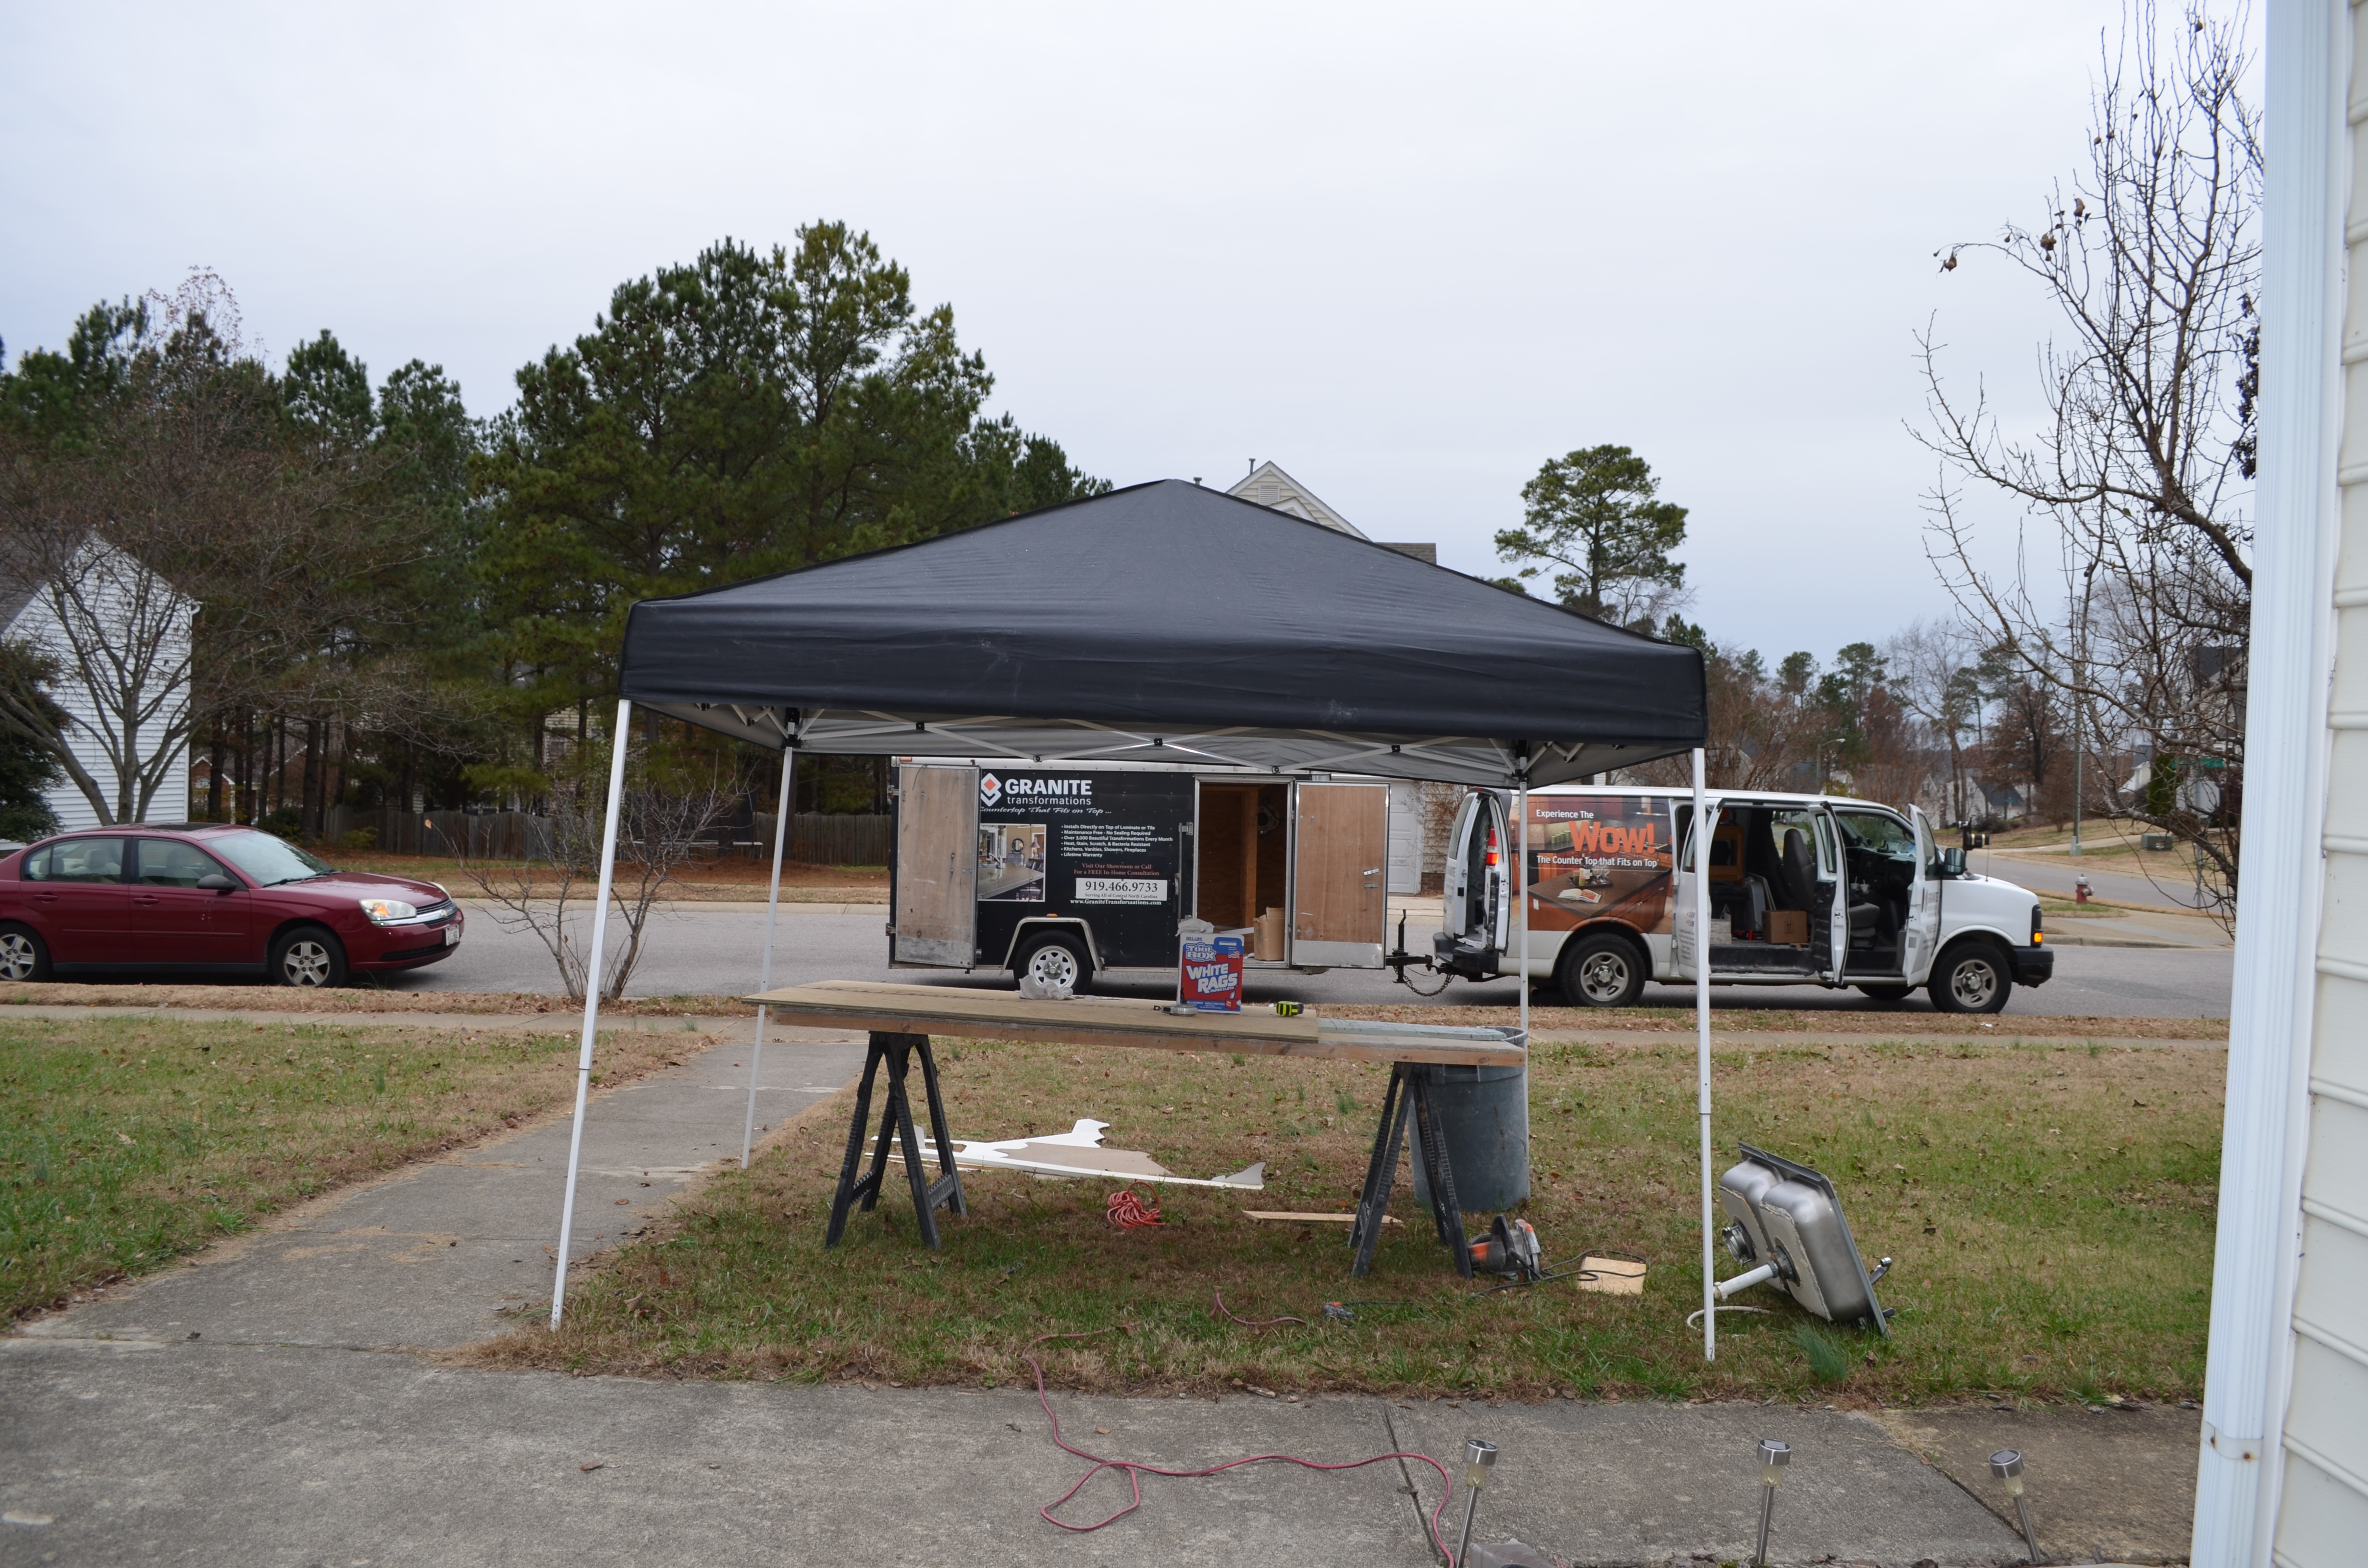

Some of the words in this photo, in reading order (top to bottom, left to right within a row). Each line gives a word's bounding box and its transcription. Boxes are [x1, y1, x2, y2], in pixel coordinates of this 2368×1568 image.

[1005, 779, 1092, 795] GRANITE
[1007, 796, 1091, 805] transformations
[1536, 809, 1579, 819] Experience
[1580, 810, 1594, 819] The
[1537, 855, 1551, 864] The
[1552, 856, 1583, 865] Counter
[1584, 857, 1598, 866] Top
[1598, 857, 1615, 866] that
[1617, 858, 1631, 866] Fits
[1085, 881, 1158, 892] 919.466.9733
[1187, 951, 1215, 960] BOX
[1186, 963, 1229, 980] WHITE
[1197, 973, 1238, 993] RAGS
